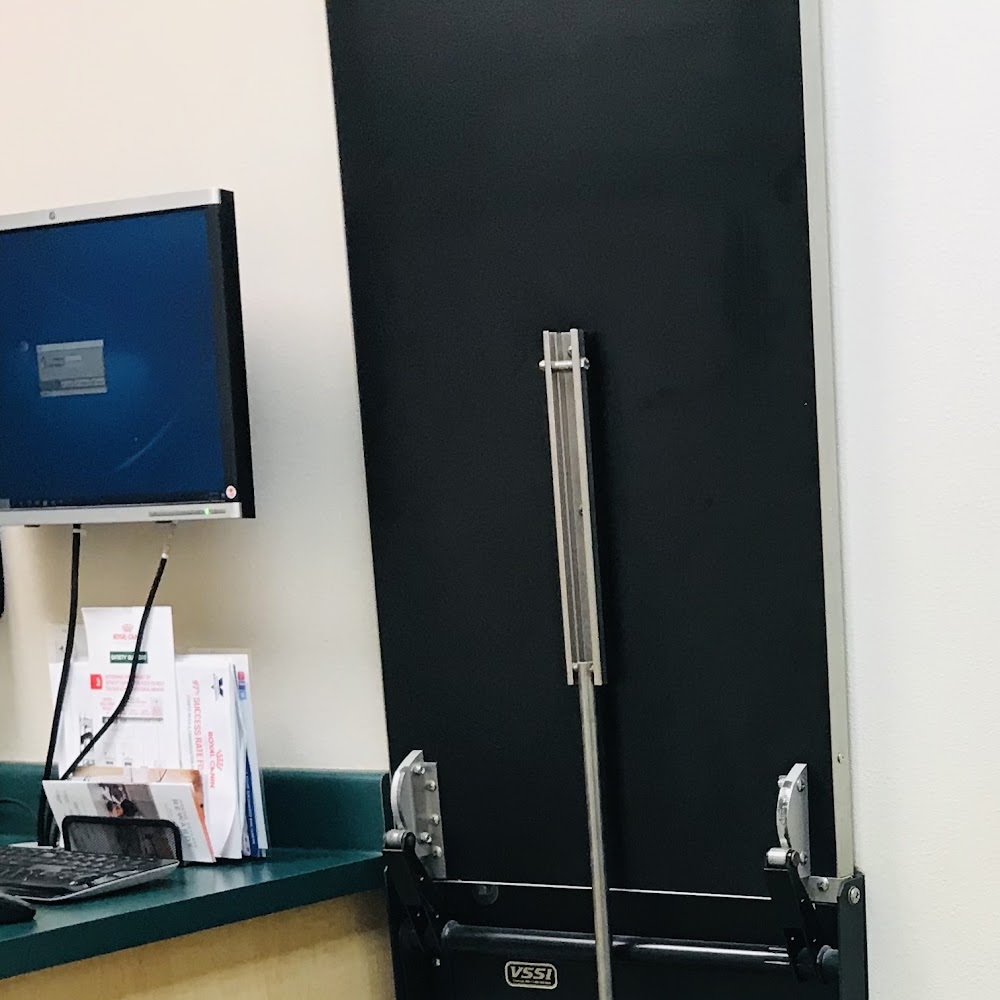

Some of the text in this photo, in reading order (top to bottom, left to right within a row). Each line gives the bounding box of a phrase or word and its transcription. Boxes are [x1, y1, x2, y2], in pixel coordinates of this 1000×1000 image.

[193, 697, 202, 735] SUCCESS
[195, 737, 203, 757] RATE
[510, 966, 552, 980] VSSI
